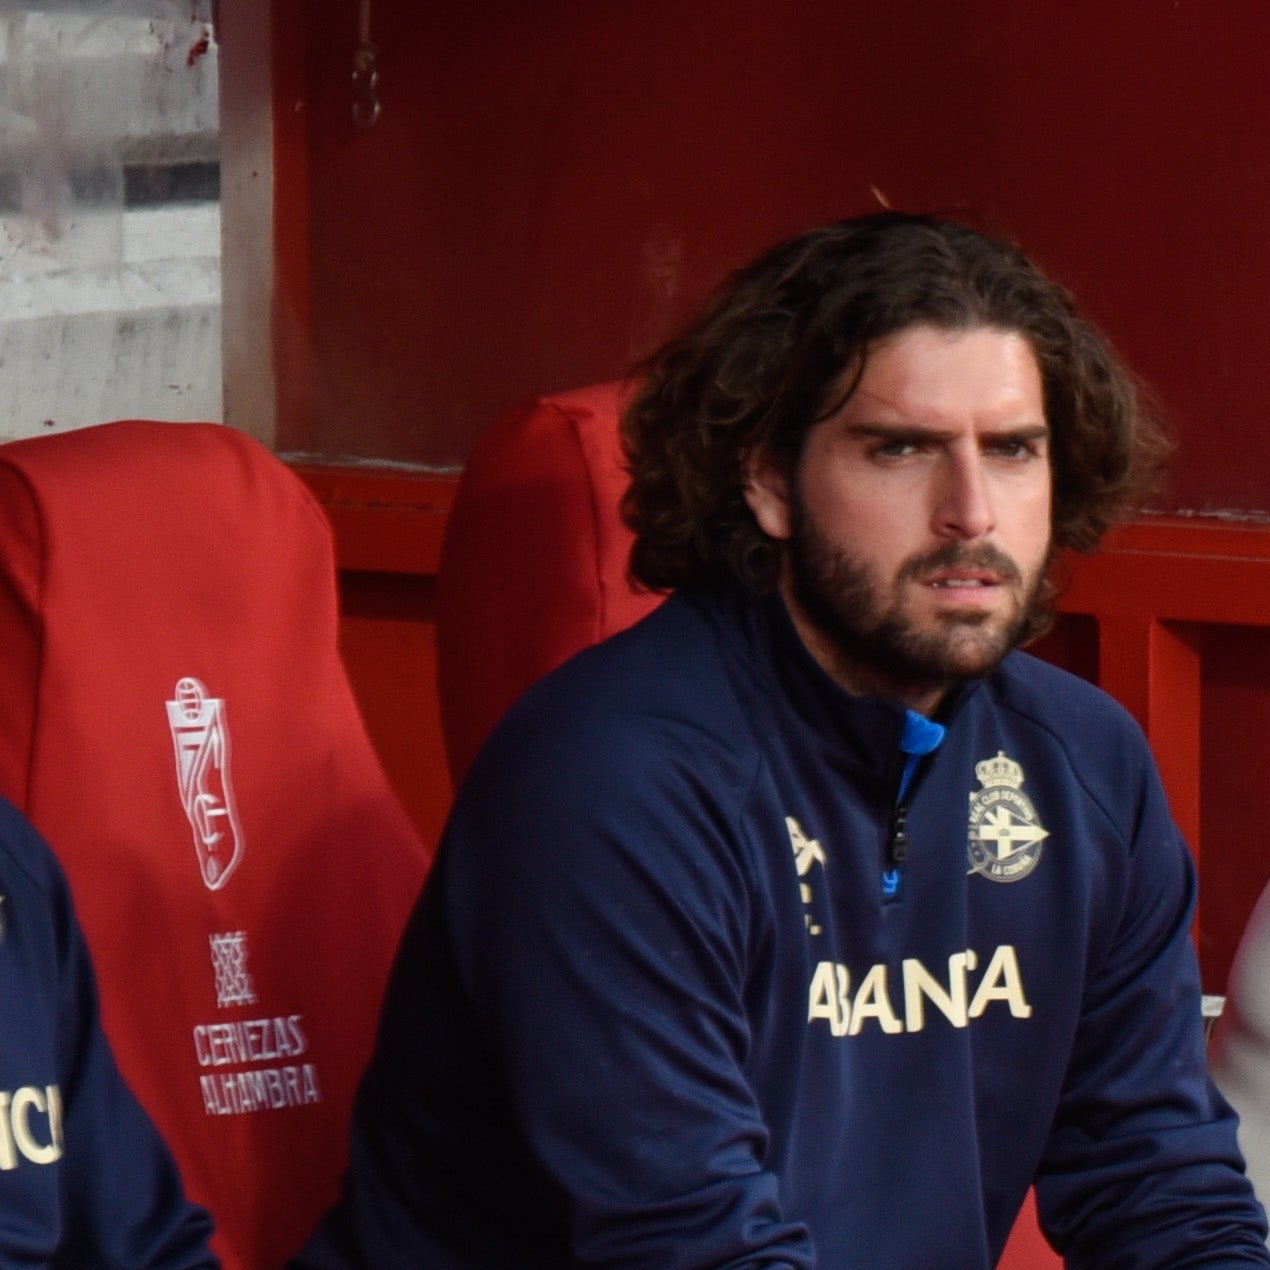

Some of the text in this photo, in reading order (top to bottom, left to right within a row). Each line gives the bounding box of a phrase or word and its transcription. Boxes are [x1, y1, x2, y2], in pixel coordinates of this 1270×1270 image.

[808, 944, 1032, 1037] ABANA
[193, 1015, 304, 1066] CERVEZAS
[200, 1064, 318, 1115] ALHAMBRA
